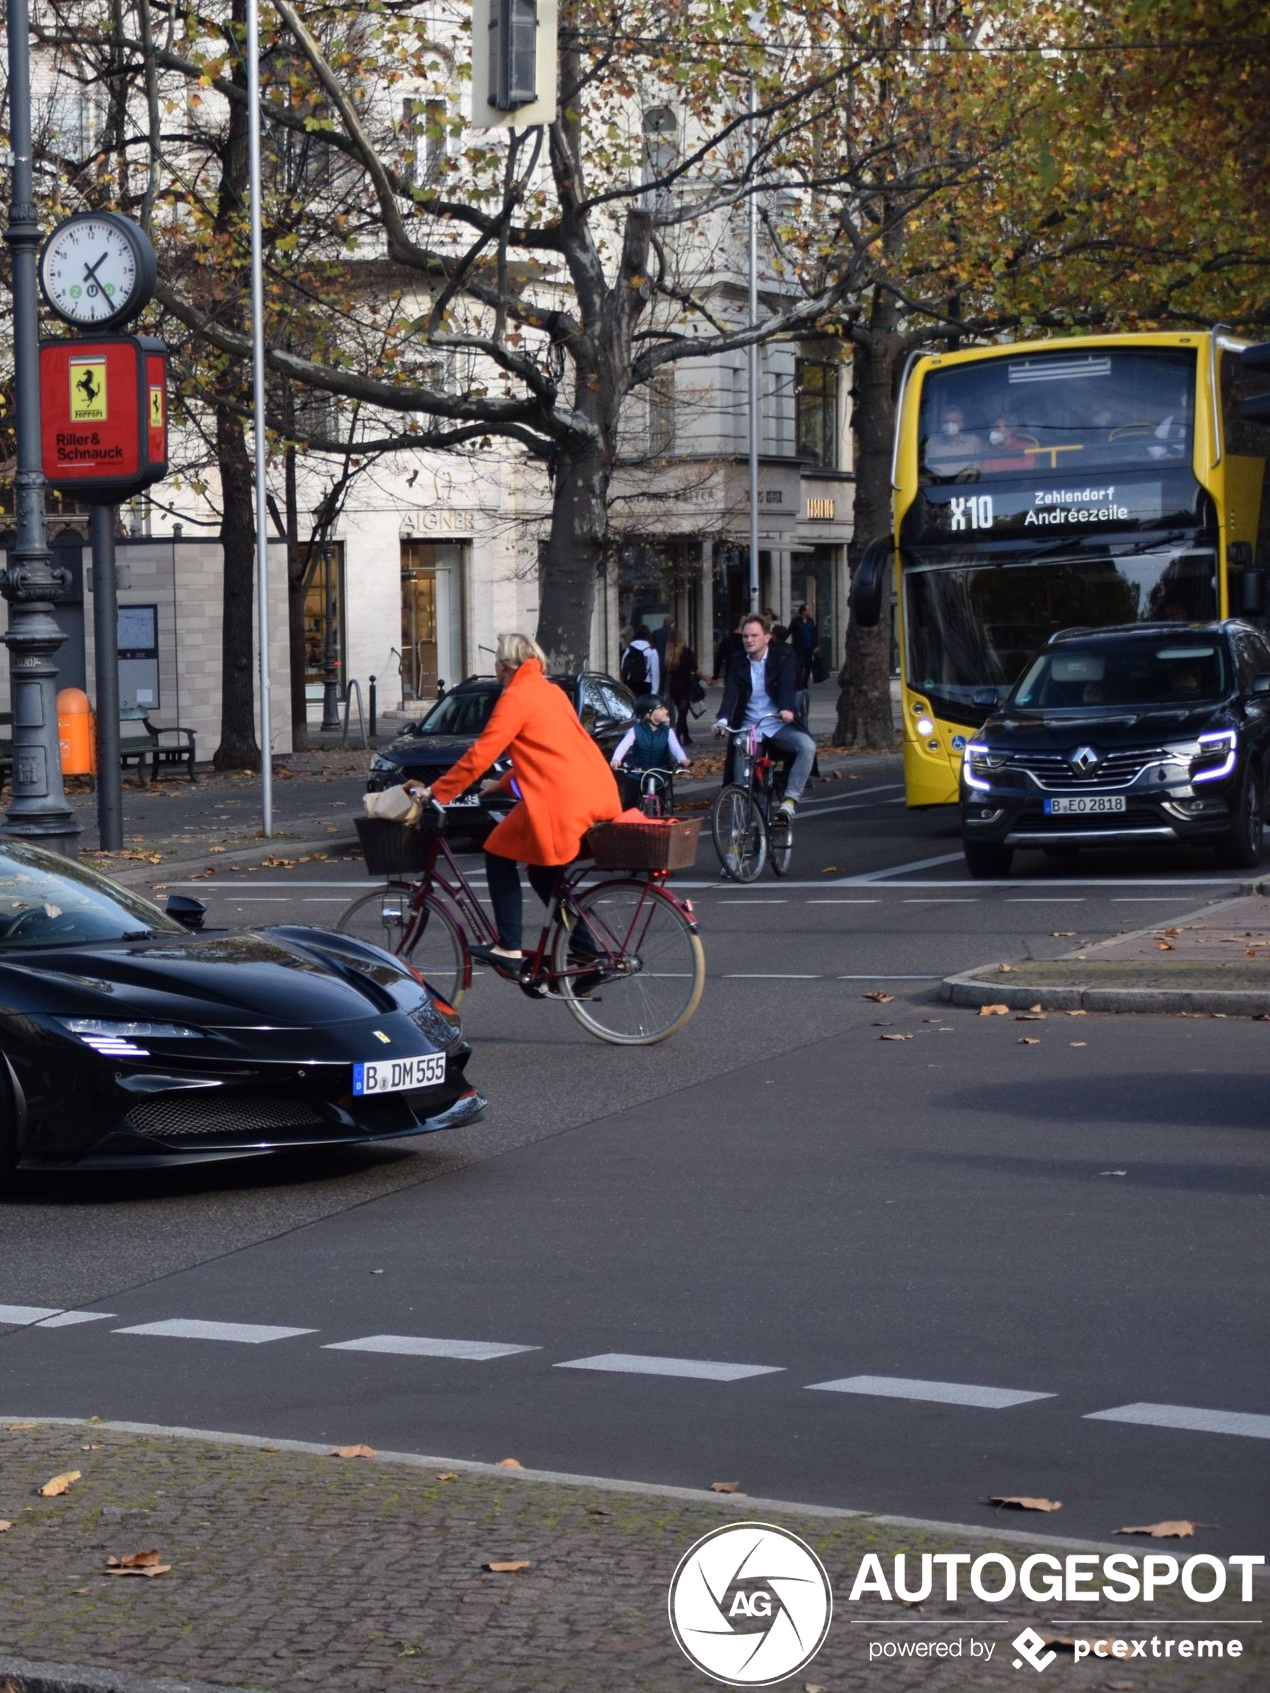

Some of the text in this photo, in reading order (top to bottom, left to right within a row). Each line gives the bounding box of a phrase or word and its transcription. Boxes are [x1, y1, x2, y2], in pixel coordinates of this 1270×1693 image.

[87, 231, 95, 240] 12
[72, 238, 79, 246] 11
[60, 252, 68, 260] 10
[118, 249, 123, 257] 2
[122, 267, 127, 275] 3
[119, 285, 124, 293] 4
[74, 301, 78, 309] 7
[90, 306, 95, 314] 6
[74, 409, 103, 419] Ferrari
[56, 432, 101, 446] Riller &
[57, 446, 123, 461] Schnauck
[1034, 486, 1115, 504] Zehlendorf
[950, 495, 993, 531] X10
[1024, 505, 1128, 526] Andréezeile
[399, 512, 474, 530] AIGNER
[1052, 797, 1123, 812] B EO 2818
[366, 1056, 445, 1091] B DM 555
[356, 1082, 362, 1090] D
